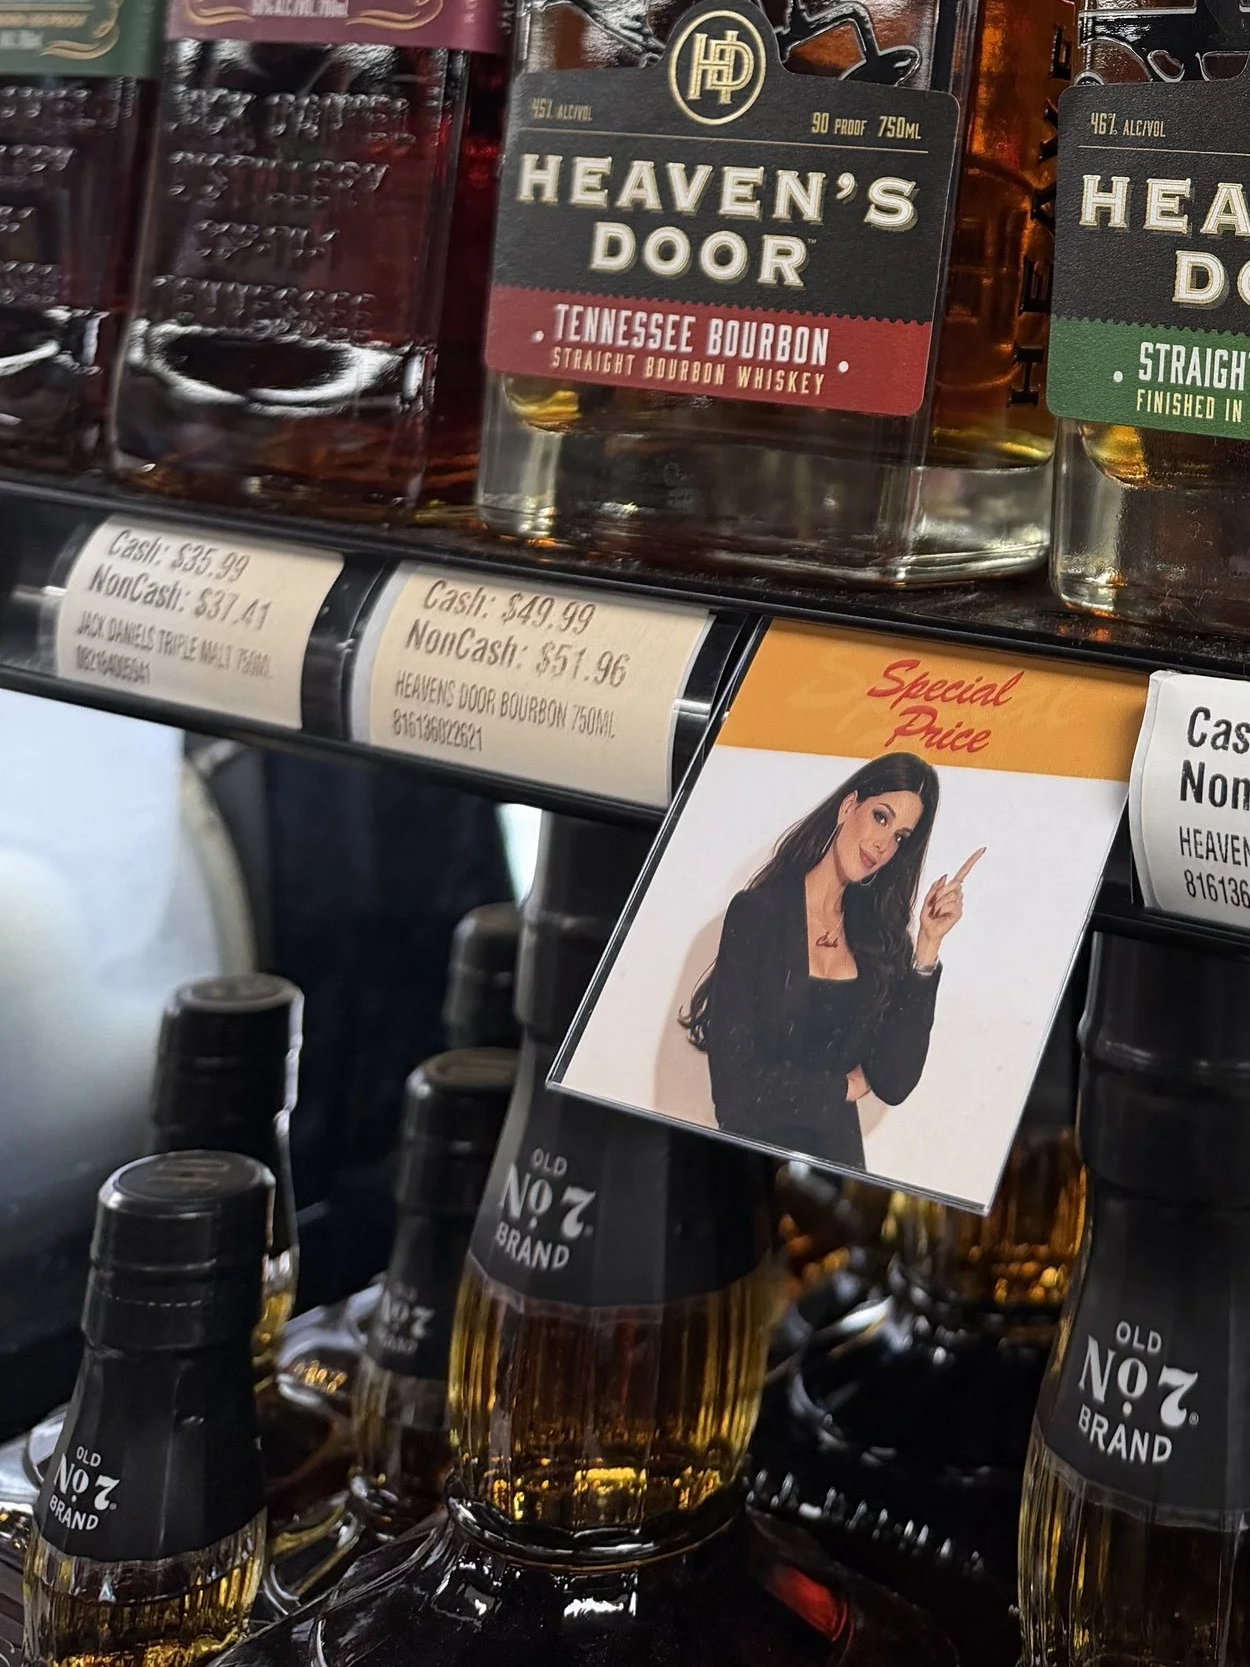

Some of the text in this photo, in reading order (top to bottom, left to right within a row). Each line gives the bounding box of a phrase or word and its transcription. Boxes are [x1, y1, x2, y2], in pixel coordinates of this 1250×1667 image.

[811, 112, 922, 140] 90 PROOF 750ML
[1090, 111, 1166, 138] 46% ALC/VOL
[515, 153, 920, 232] HEAVEN'S
[590, 221, 808, 289] DOOR
[554, 302, 830, 367] TENNESSEE BOURBON
[551, 346, 826, 396] STRAIGHT BOURBON WHISKEY
[1136, 387, 1216, 421] FINISHED
[1224, 396, 1243, 423] IN
[108, 529, 251, 583] Cash: $35.99
[88, 563, 273, 632] NonCash: $37.41
[423, 579, 597, 635] Cash: $49.99
[157, 628, 199, 662] TRIPLE
[405, 618, 632, 688] NonCash: $51.96
[395, 669, 456, 708] HEAVENS
[458, 683, 496, 716] DOOR
[500, 690, 567, 729] BOURBON
[867, 658, 1026, 710] Special
[884, 705, 993, 754] Price
[531, 1147, 568, 1176] OLD
[496, 1221, 570, 1270] BRAND
[1115, 1320, 1162, 1354] OLD
[76, 1445, 102, 1467] OLD
[1078, 1403, 1173, 1465] BRAND
[49, 1494, 99, 1531] BRAND
